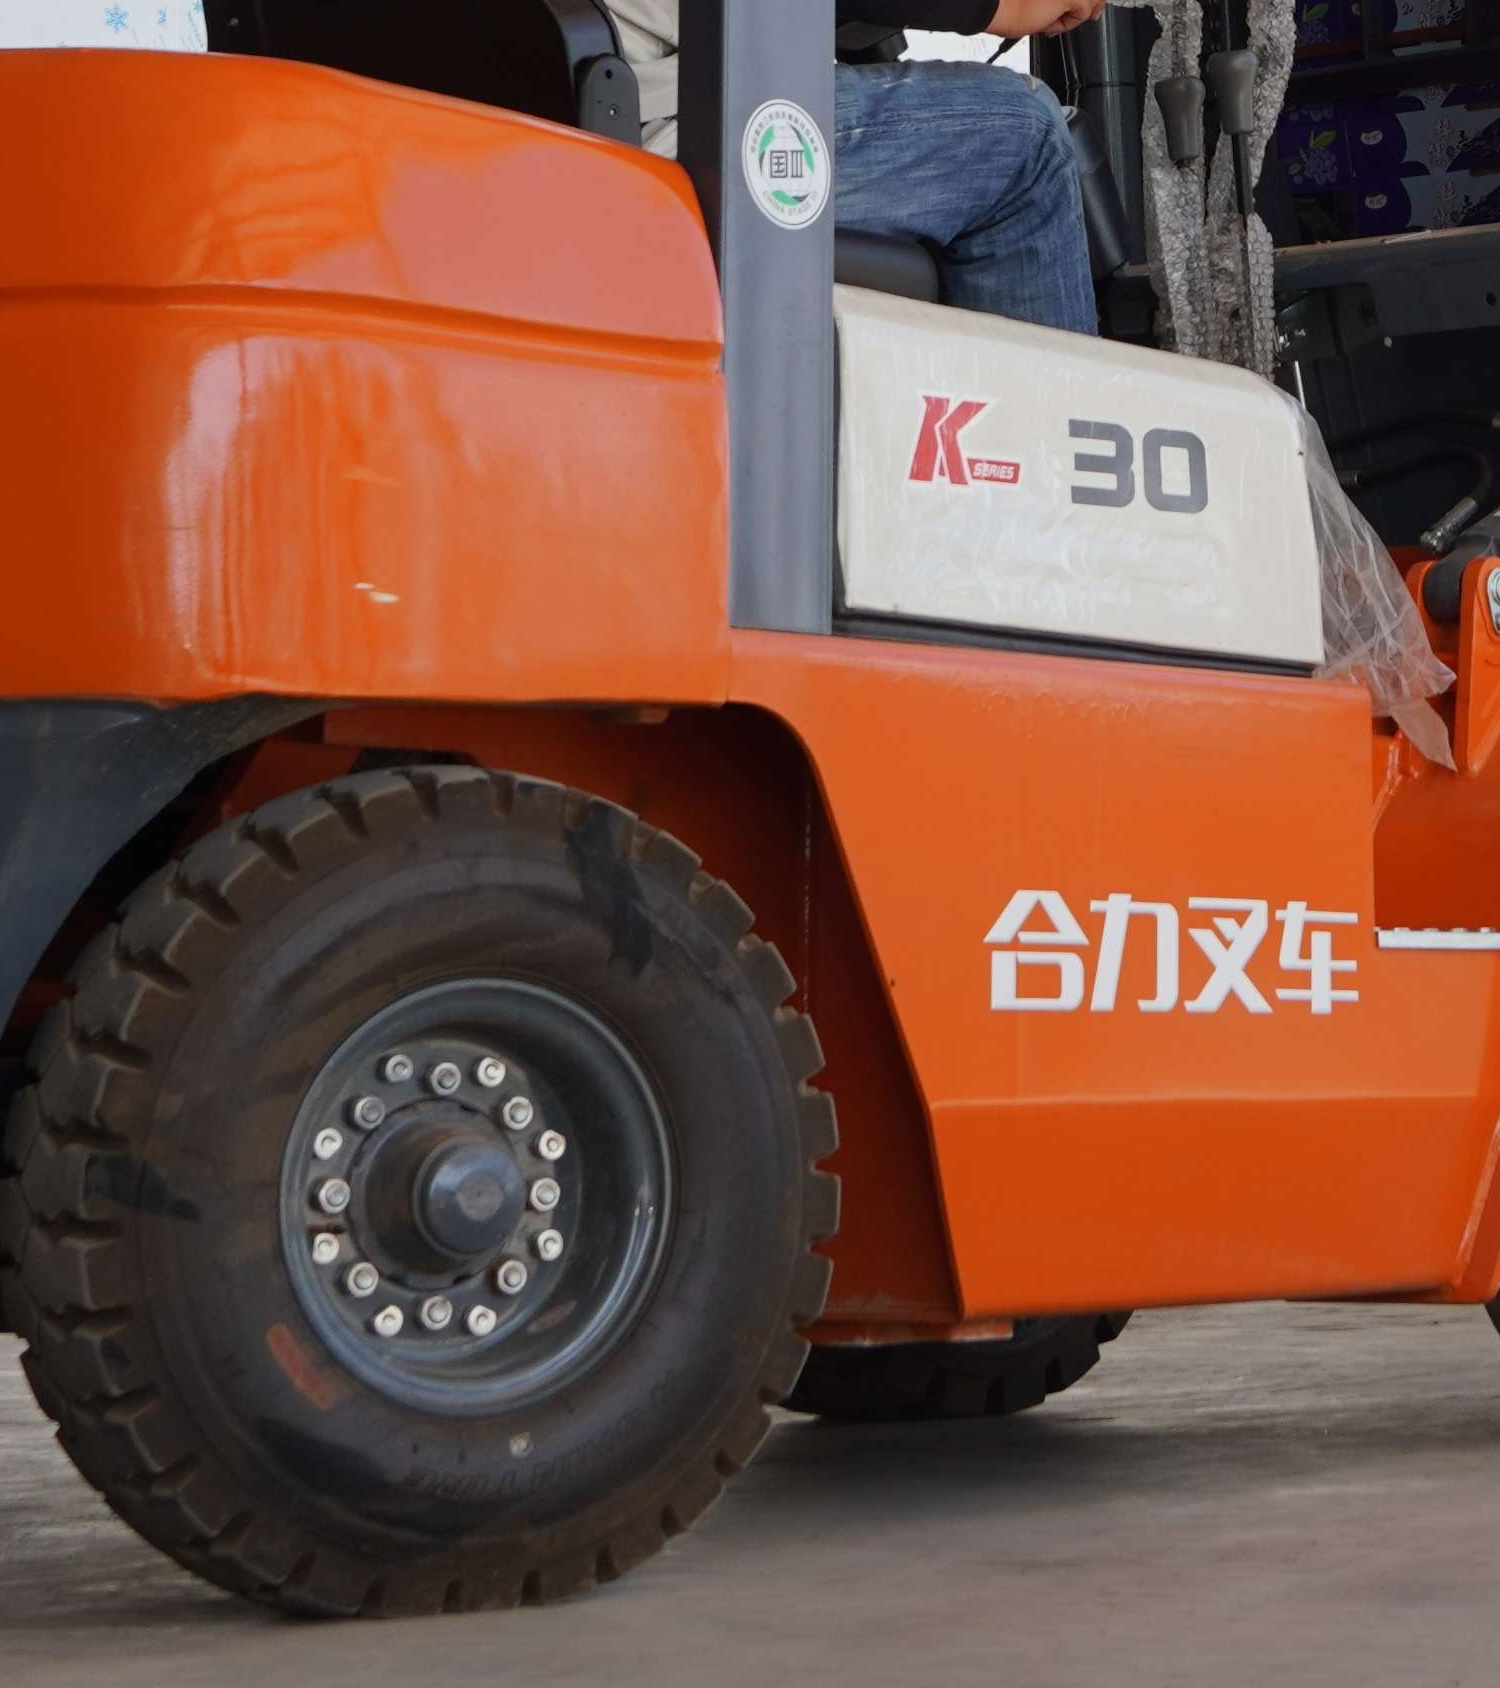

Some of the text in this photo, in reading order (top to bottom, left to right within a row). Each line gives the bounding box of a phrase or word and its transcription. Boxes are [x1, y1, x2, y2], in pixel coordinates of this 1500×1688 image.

[909, 395, 988, 485] K
[1068, 417, 1209, 514] 30
[983, 888, 1359, 1015] 合力叉车
